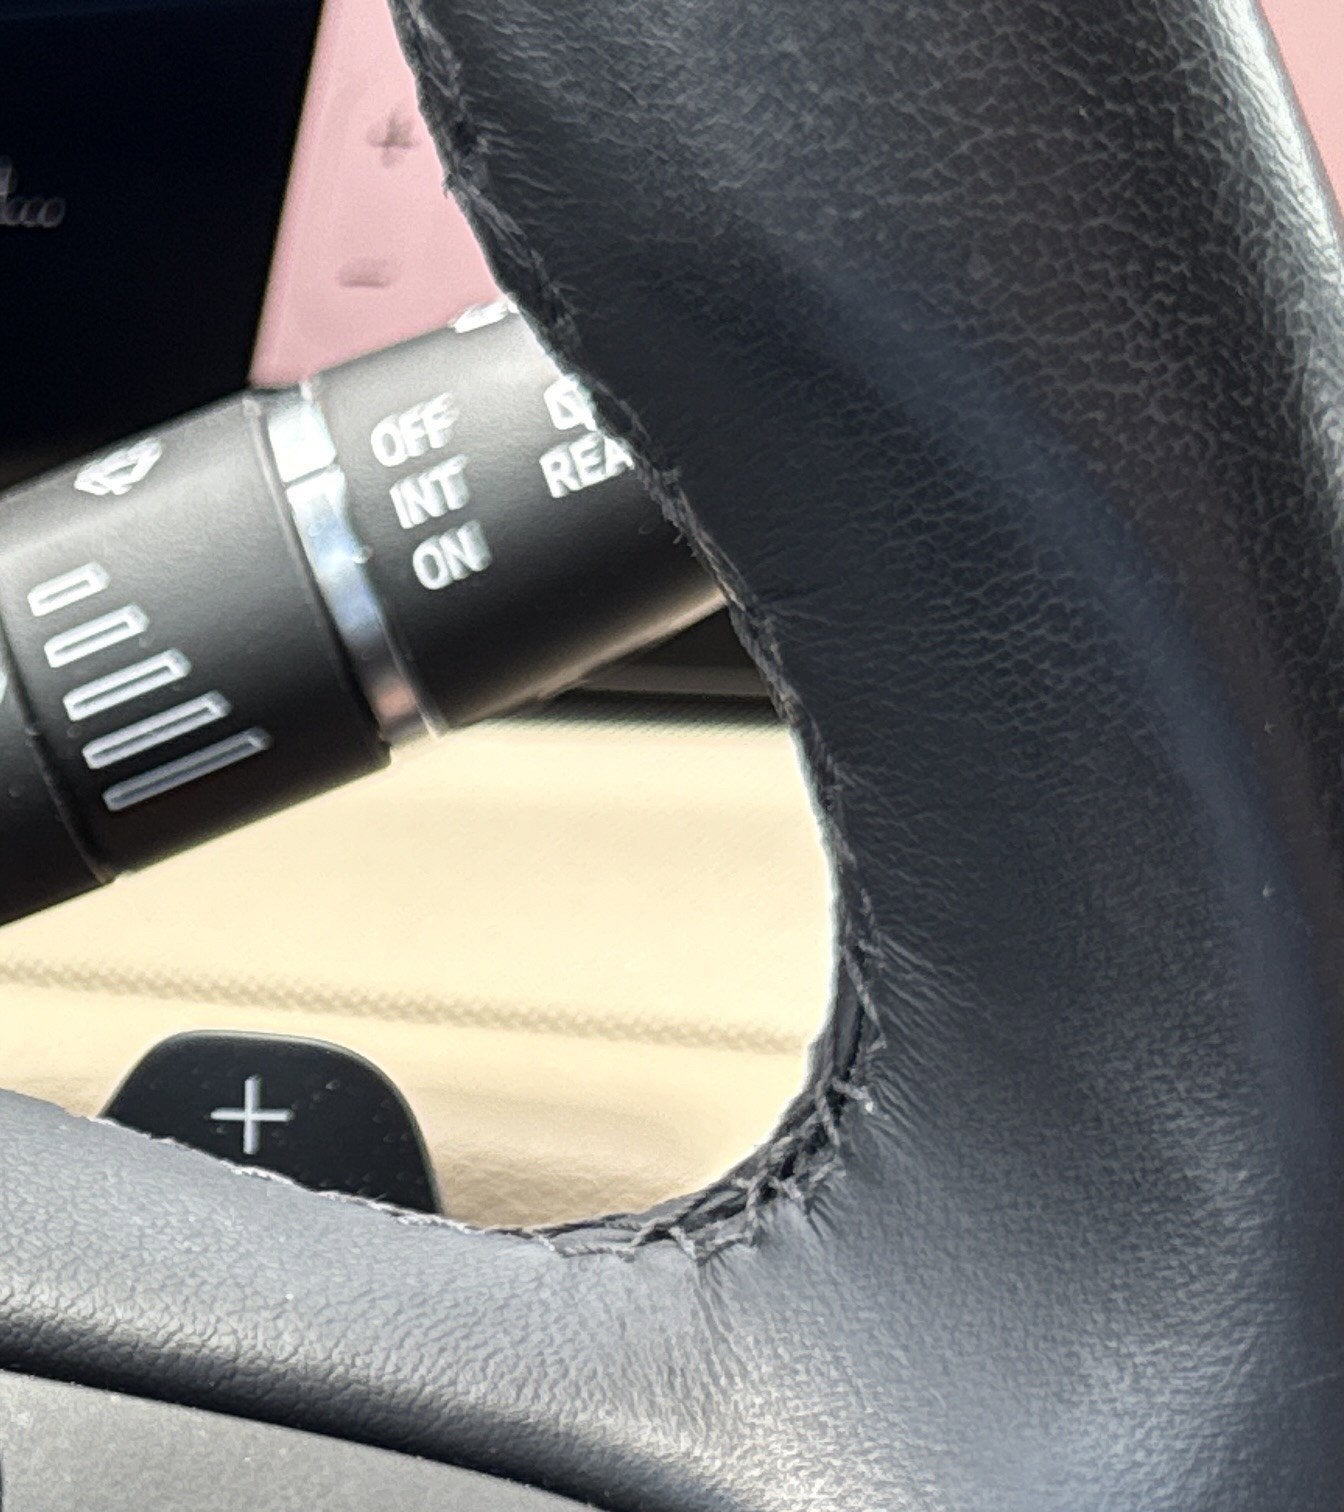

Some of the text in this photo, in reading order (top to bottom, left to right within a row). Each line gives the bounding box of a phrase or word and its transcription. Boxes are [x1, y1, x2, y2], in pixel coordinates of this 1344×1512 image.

[371, 392, 463, 467] OFF
[538, 431, 635, 499] REA
[389, 455, 470, 529] INT
[412, 520, 493, 590] ON
